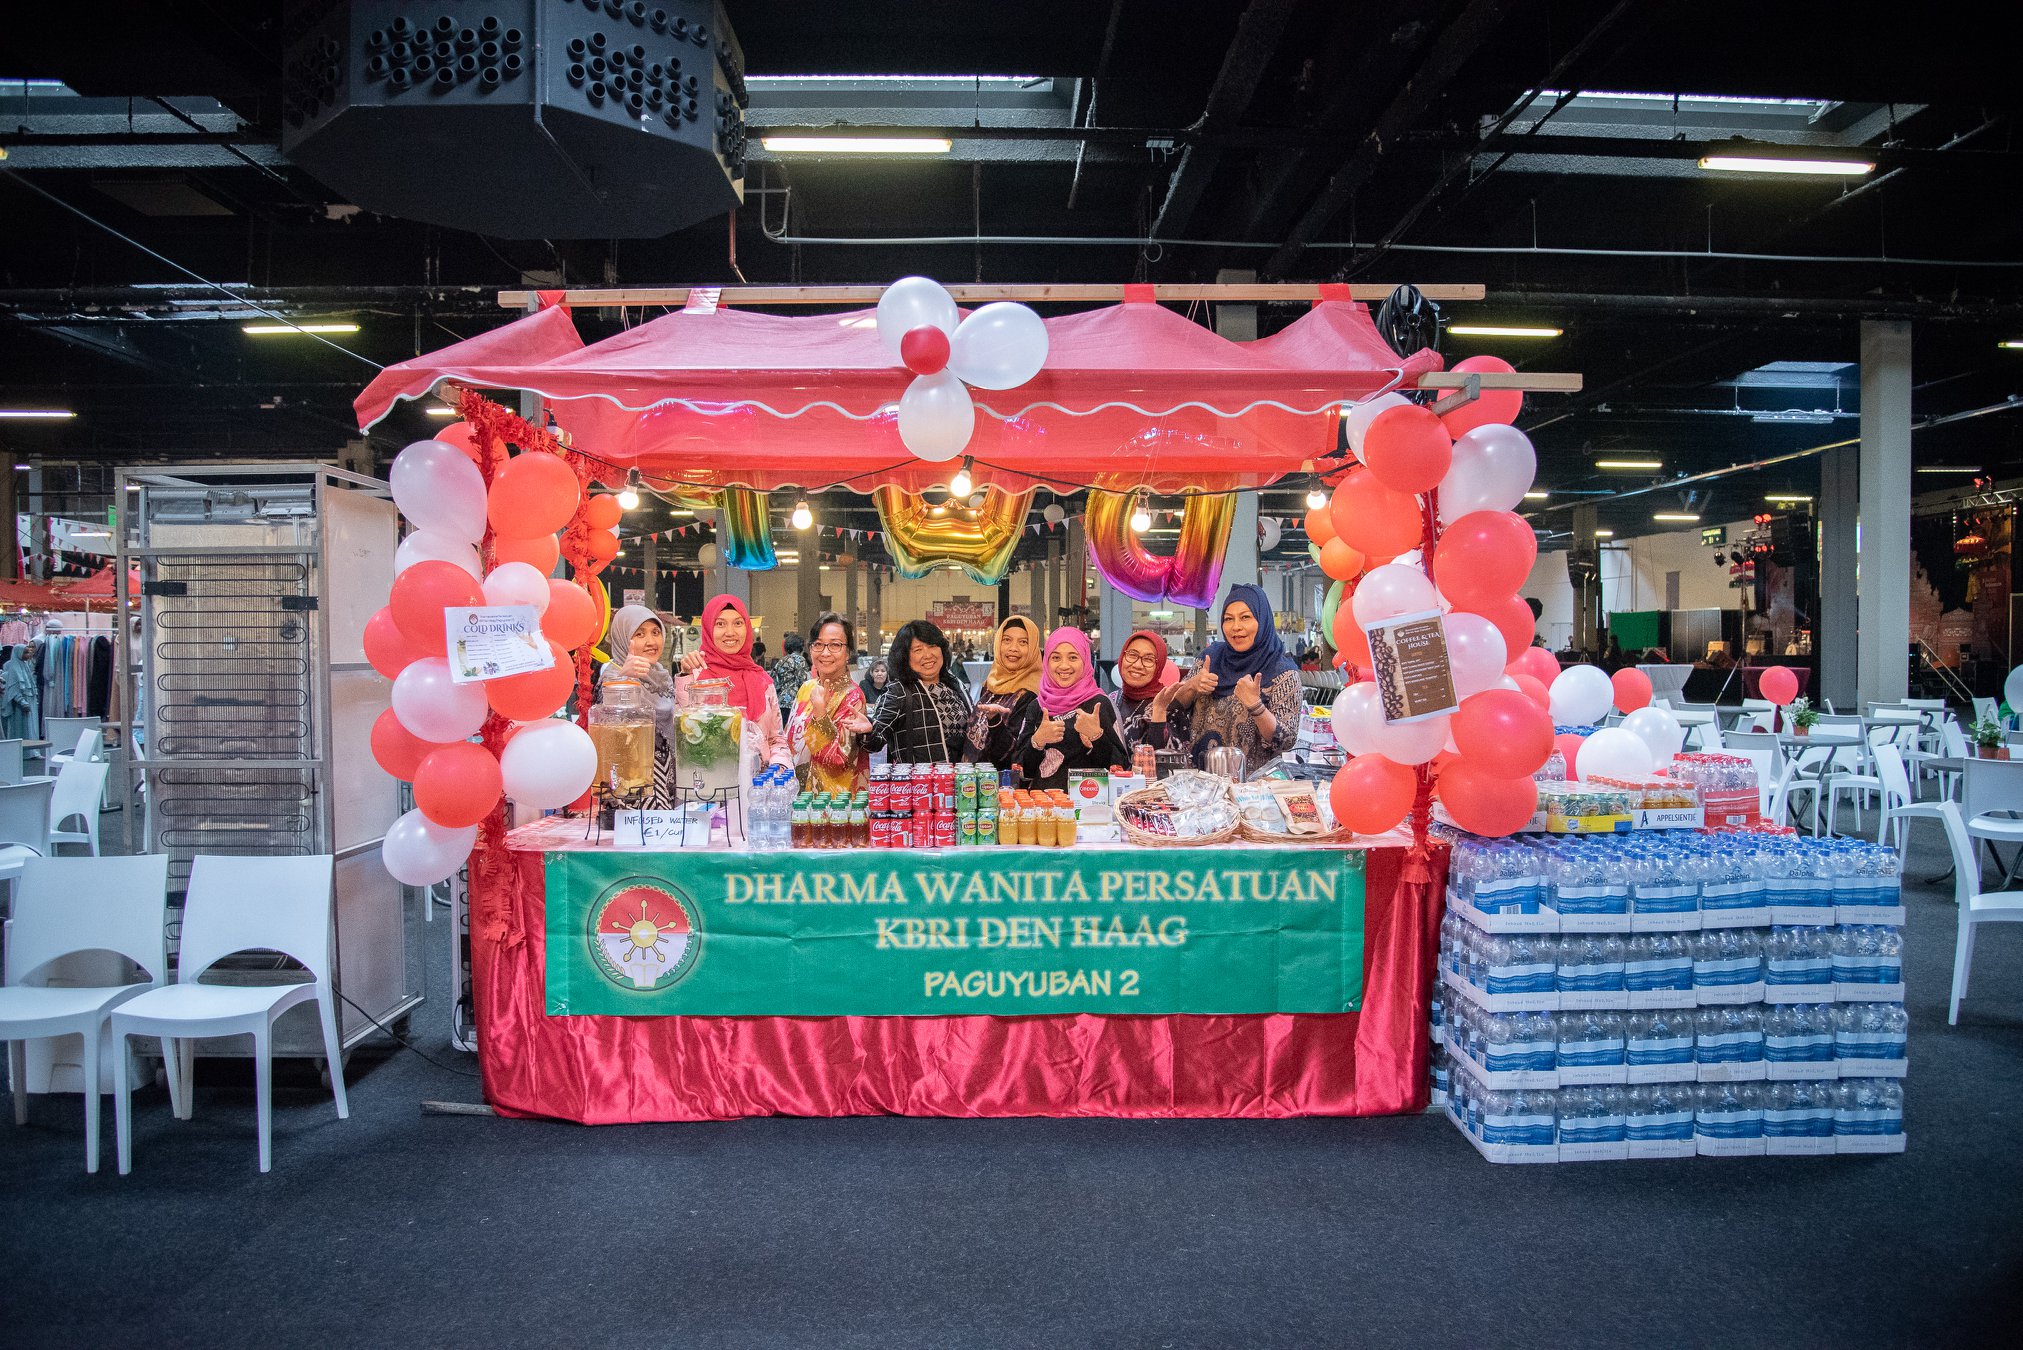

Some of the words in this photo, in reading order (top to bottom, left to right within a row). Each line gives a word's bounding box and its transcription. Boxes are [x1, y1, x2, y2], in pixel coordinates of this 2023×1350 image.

[464, 625, 487, 634] COLD
[488, 621, 524, 633] DRINKS
[1395, 635, 1421, 645] COFFEE
[1427, 631, 1441, 639] TEA
[1407, 640, 1430, 650] HOUSE
[1656, 813, 1697, 822] APPELSIENTJE
[726, 870, 907, 904] DHARMA
[916, 870, 1090, 904] WANITA
[1100, 870, 1339, 904] PERSATUAN
[875, 916, 968, 949] KBRI
[978, 916, 1061, 949] DEN
[1071, 916, 1188, 949] HAAG
[924, 969, 1111, 997] PAGUYUBAN
[1119, 970, 1140, 997] 2
